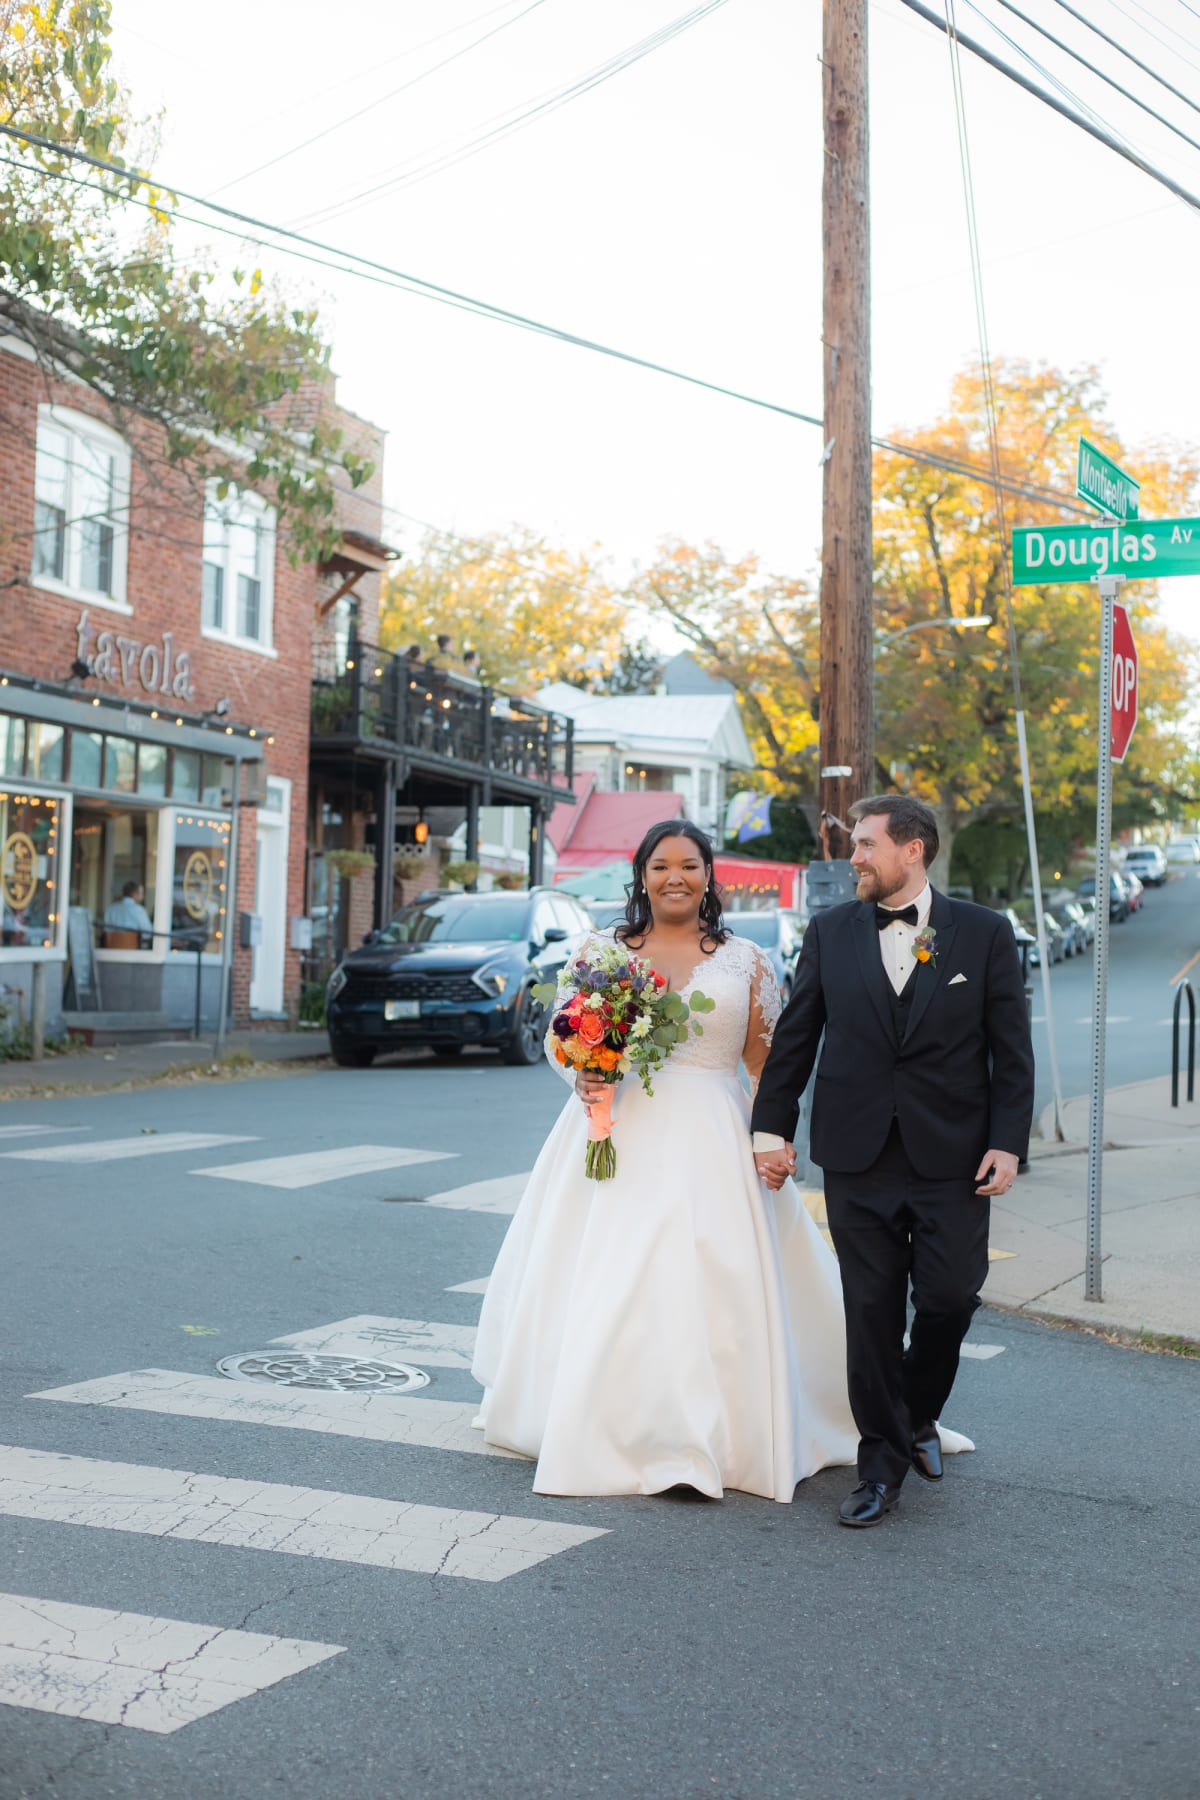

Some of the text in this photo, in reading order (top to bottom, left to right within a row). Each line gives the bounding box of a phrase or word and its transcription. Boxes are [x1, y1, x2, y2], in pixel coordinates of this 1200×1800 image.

[1080, 449, 1127, 518] Monticello
[1026, 524, 1194, 575] Douglas Av
[76, 608, 196, 701] tavola
[1112, 653, 1136, 713] OP
